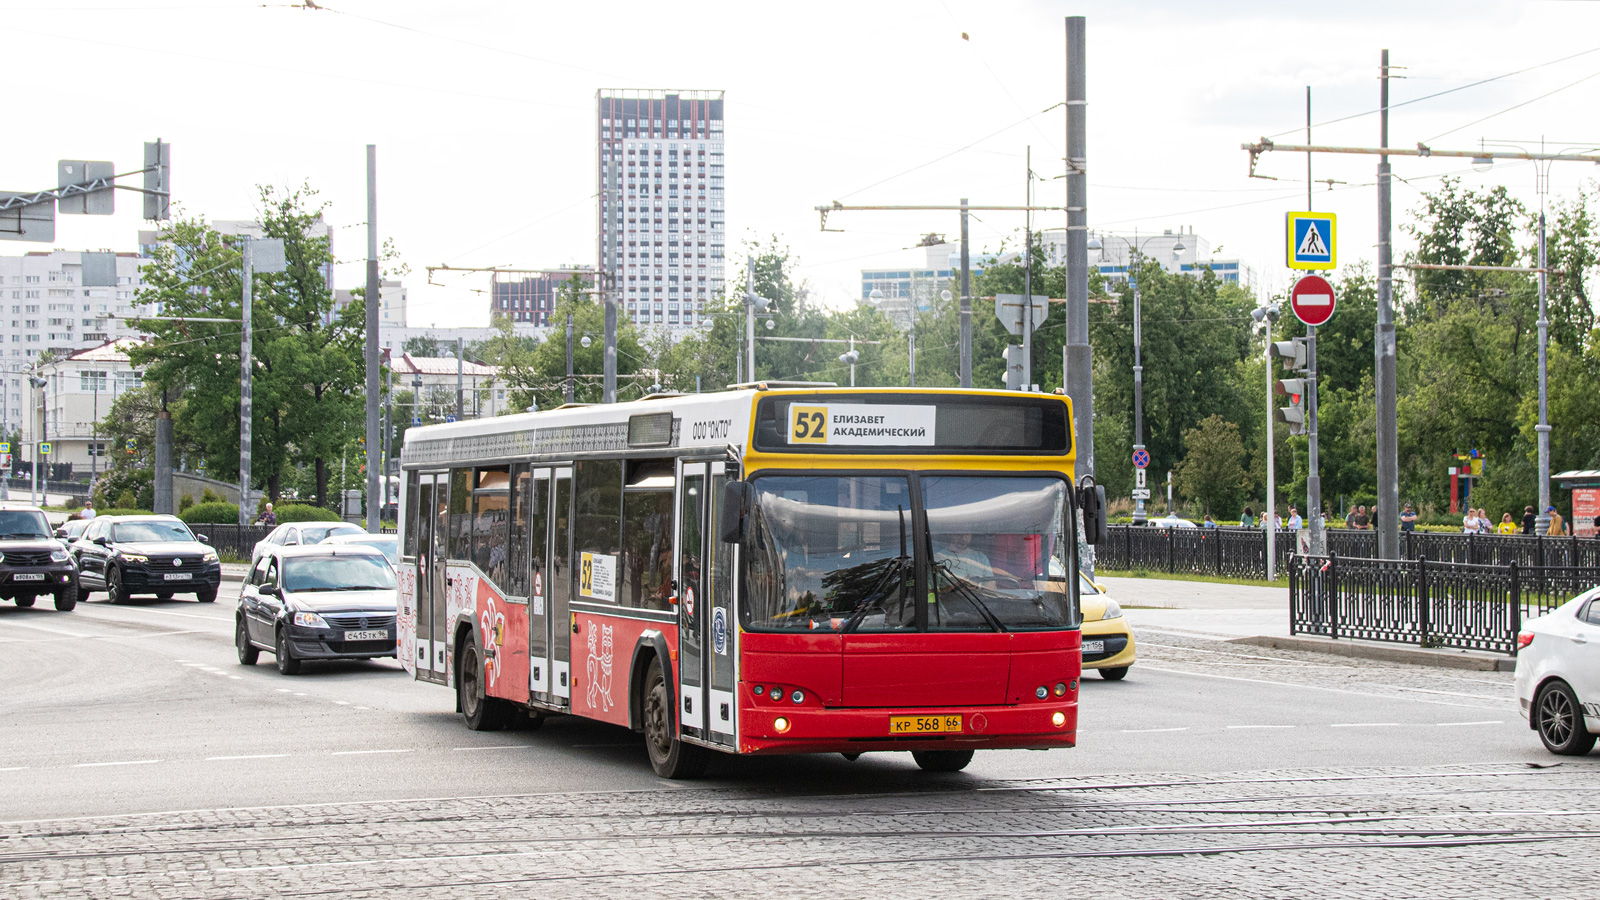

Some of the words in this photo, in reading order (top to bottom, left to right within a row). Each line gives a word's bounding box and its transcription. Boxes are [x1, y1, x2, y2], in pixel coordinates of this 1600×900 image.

[795, 412, 825, 438] 52
[833, 415, 885, 424] ЕЛИЗАВЕТ
[693, 421, 707, 440] ООО
[833, 426, 926, 438] АКАДЕМИЧЕСКИЙ
[582, 560, 592, 590] 52
[896, 721, 911, 731] КР
[917, 718, 940, 731] 568
[946, 717, 958, 727] 66
